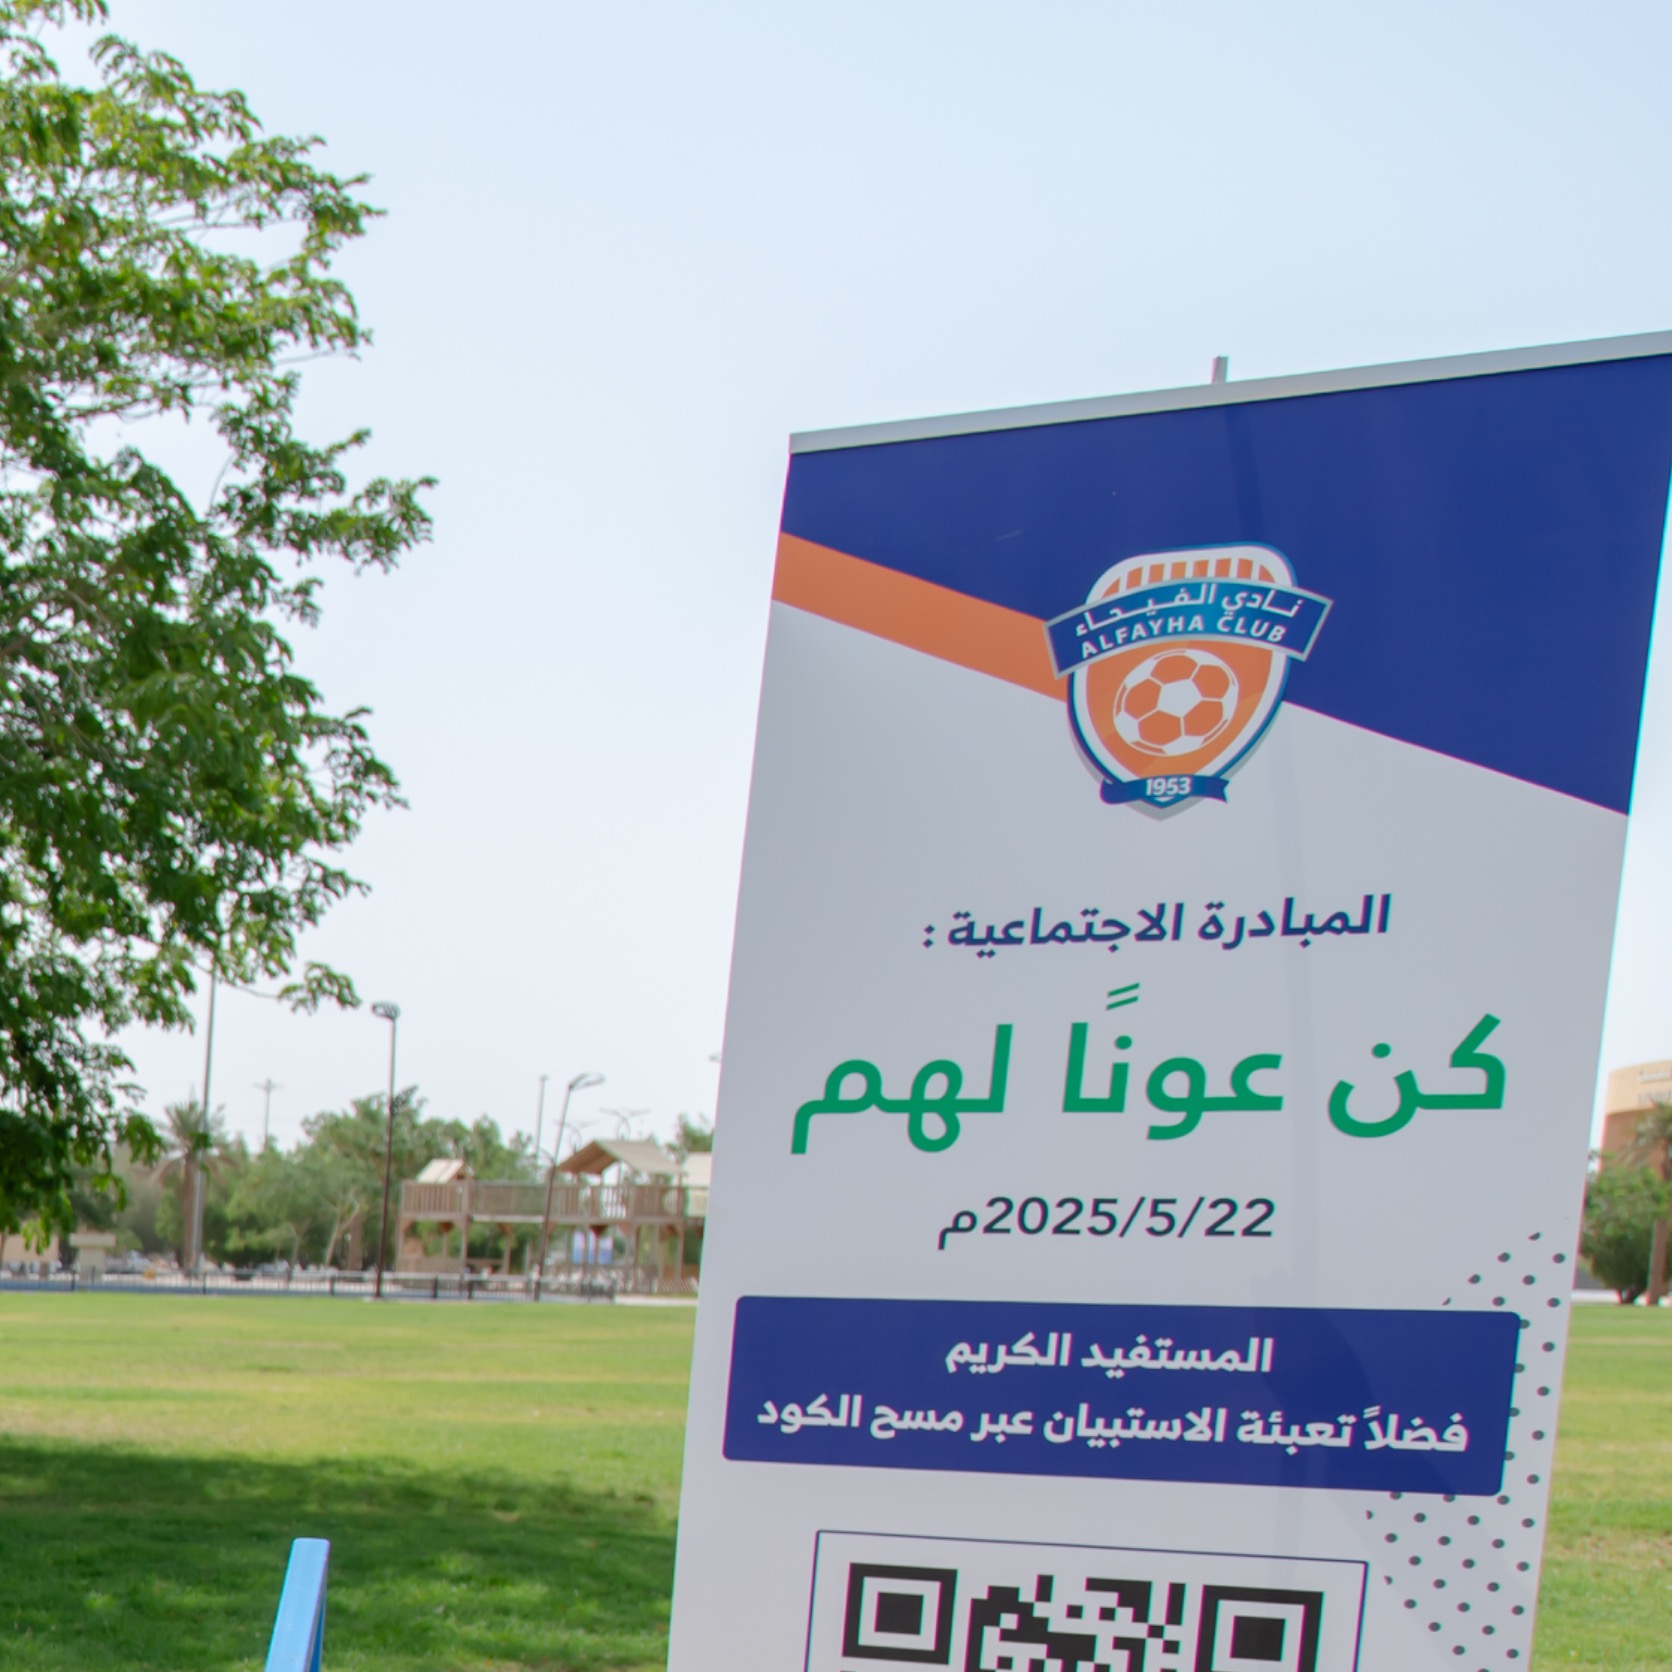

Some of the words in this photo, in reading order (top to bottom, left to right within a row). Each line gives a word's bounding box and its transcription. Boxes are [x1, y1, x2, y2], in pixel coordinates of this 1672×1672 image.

[1076, 582, 1217, 637] الفيحاء
[1221, 589, 1304, 618] نادي
[1081, 614, 1205, 660] ALFAYHA
[1216, 614, 1287, 643] CLUB
[1146, 776, 1192, 796] 1953
[947, 901, 1185, 959] الاجتماعية
[1197, 892, 1393, 951] المبادرة
[790, 1023, 1014, 1155] لهم
[1329, 1012, 1507, 1139] كن
[944, 1331, 1073, 1377] الكريم
[1080, 1334, 1275, 1379] المستفيد
[756, 1393, 863, 1434] الكود
[869, 1405, 965, 1441] مسح
[969, 1410, 1035, 1445] عبر
[1042, 1403, 1229, 1449] الاستبيان
[1236, 1410, 1358, 1456] تعبئة
